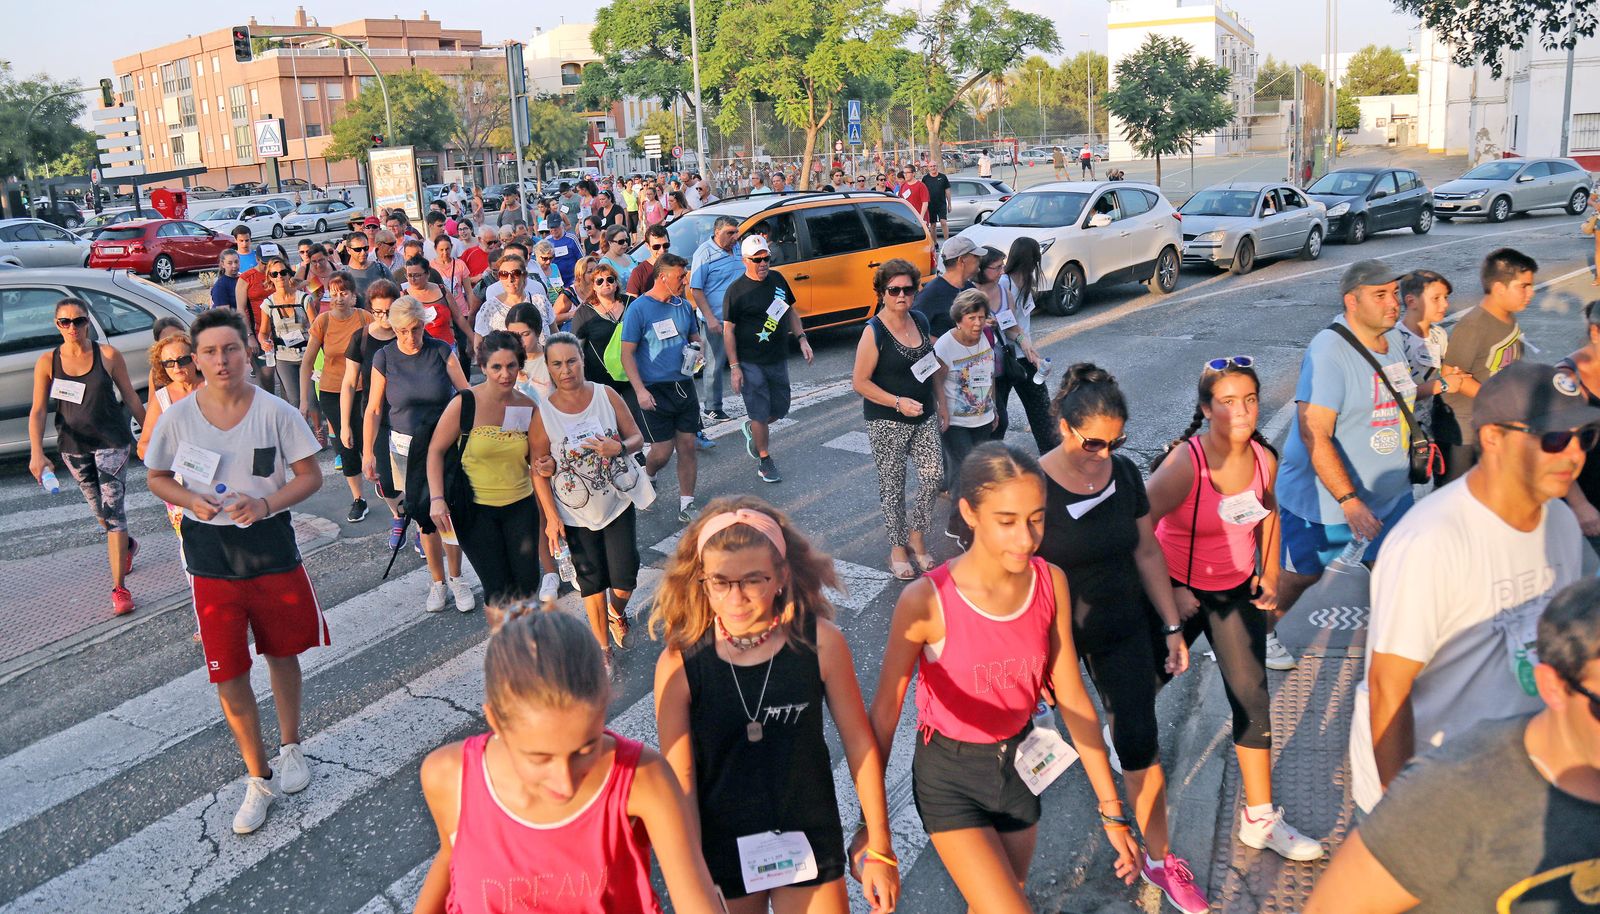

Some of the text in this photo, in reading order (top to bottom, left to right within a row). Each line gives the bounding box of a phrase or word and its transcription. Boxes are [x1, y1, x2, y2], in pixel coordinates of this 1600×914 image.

[261, 145, 280, 153] ALDI
[1373, 441, 1399, 450] CROSS
[972, 653, 1047, 695] DREAM
[481, 866, 608, 914] DREAM
